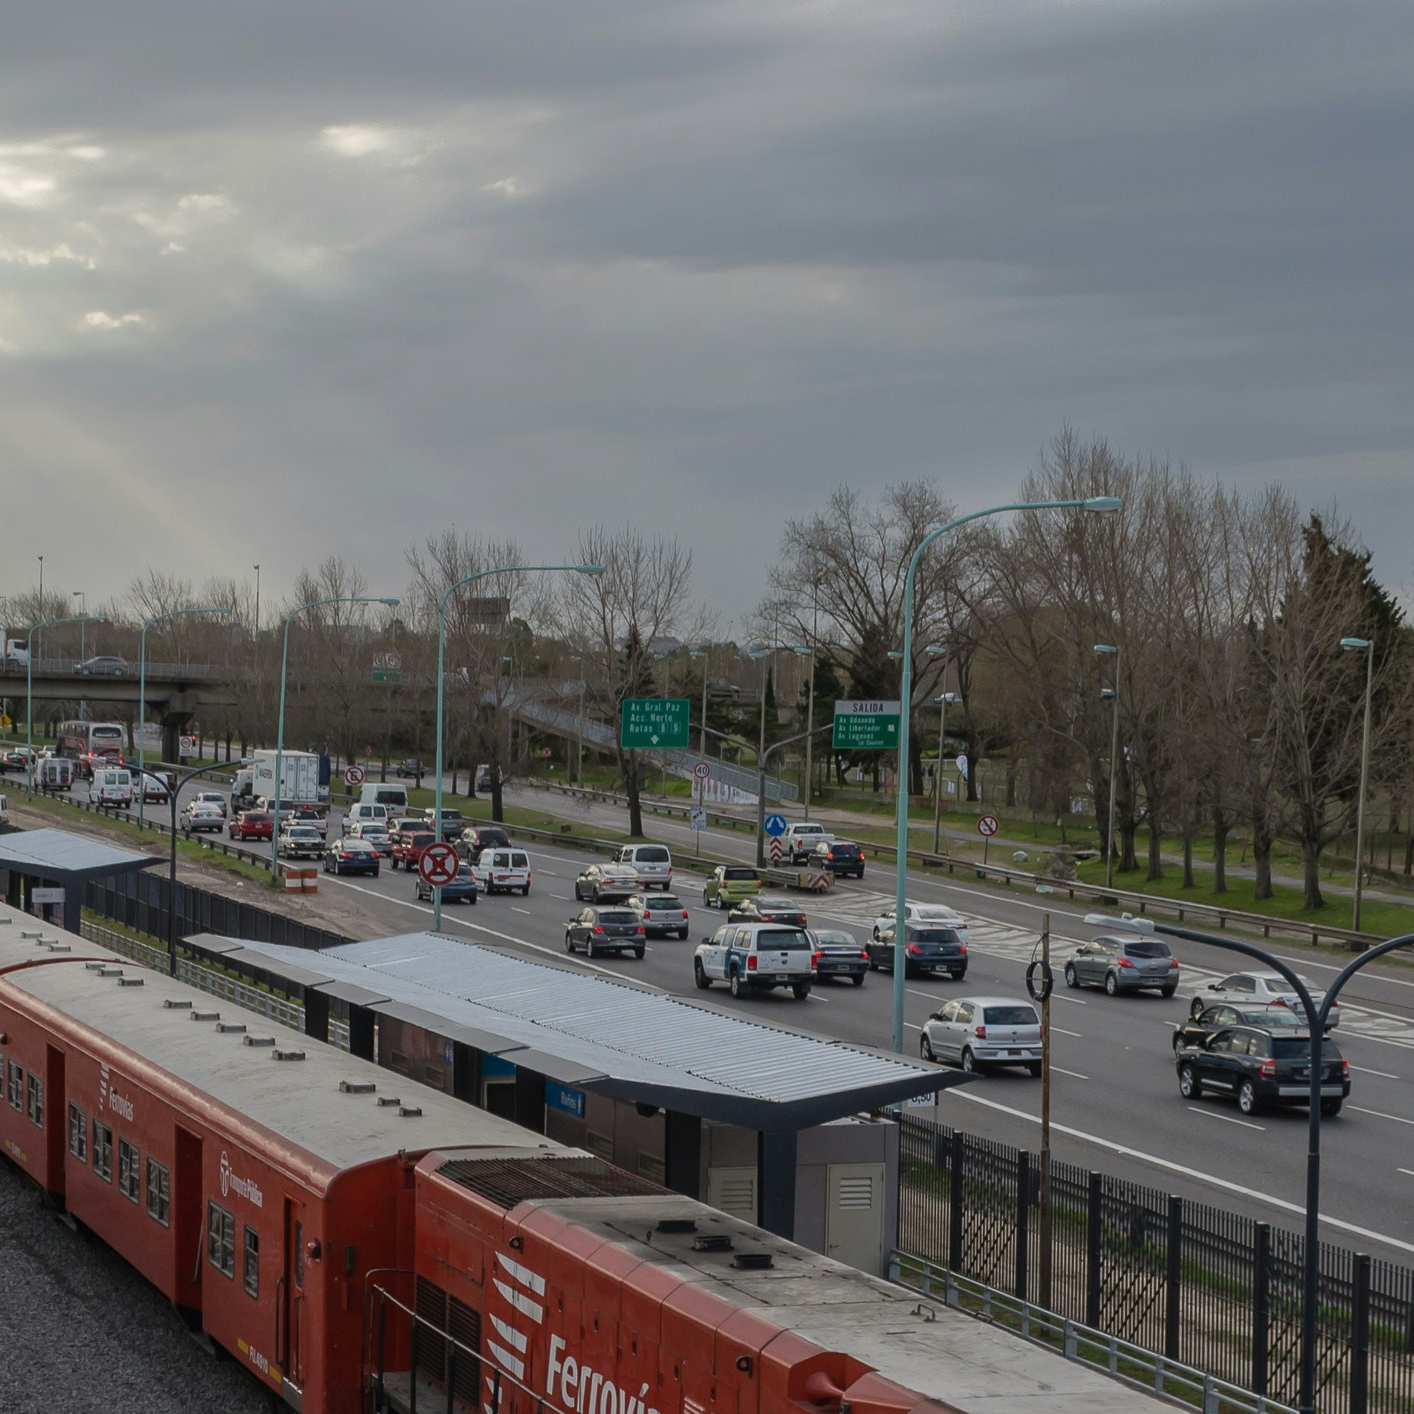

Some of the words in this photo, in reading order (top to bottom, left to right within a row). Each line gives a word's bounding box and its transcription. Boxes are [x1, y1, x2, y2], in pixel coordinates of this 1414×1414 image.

[645, 703, 663, 712] Gral.
[666, 703, 680, 712] Paz
[852, 703, 884, 712] SALIDA
[631, 713, 648, 722] Acc.
[650, 713, 673, 722] Norte
[630, 724, 653, 733] Rutas
[696, 766, 707, 775] 40
